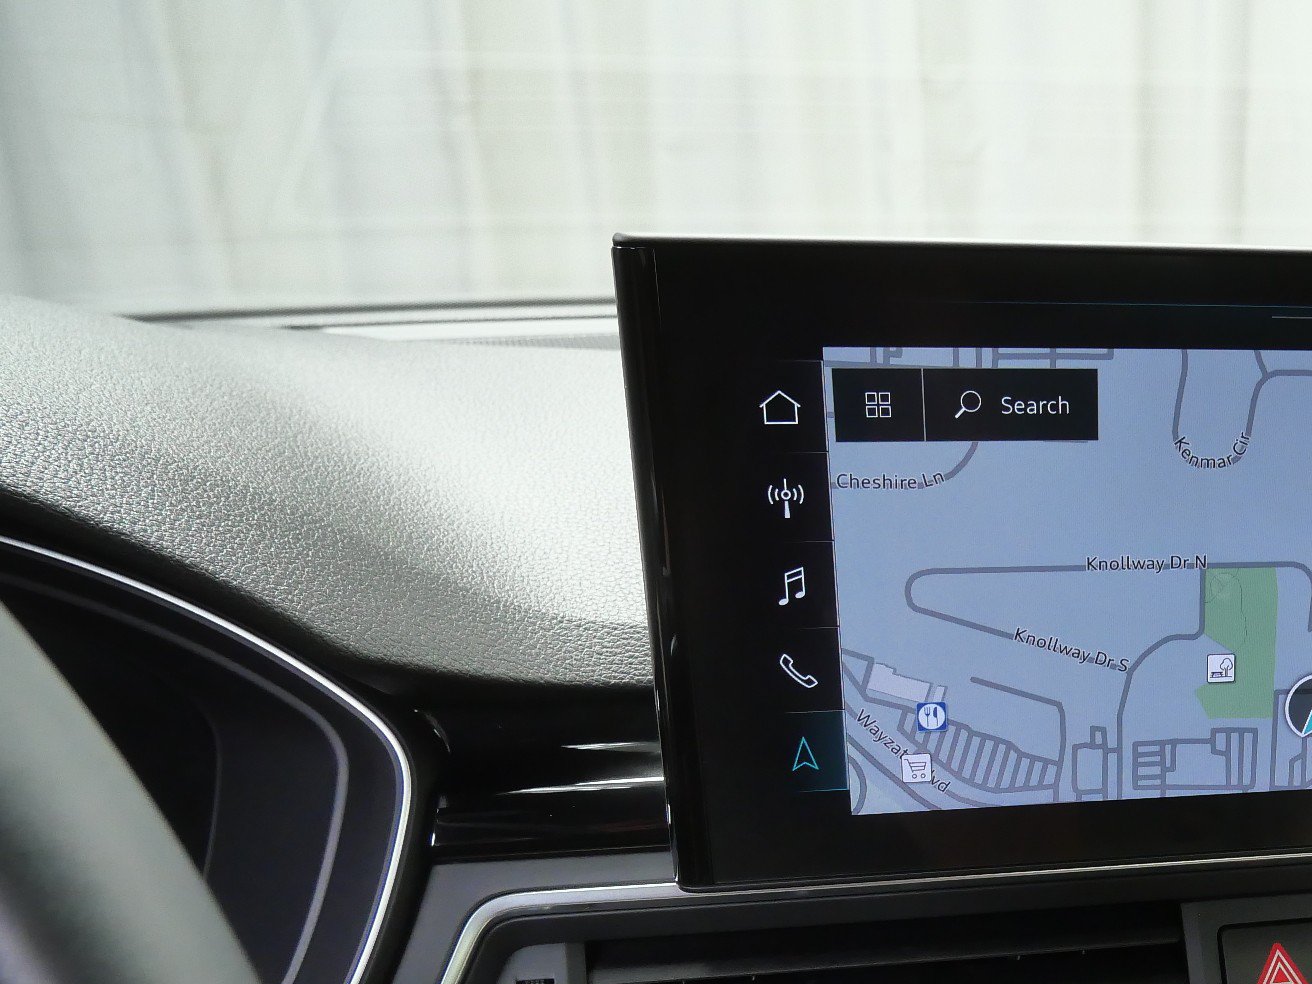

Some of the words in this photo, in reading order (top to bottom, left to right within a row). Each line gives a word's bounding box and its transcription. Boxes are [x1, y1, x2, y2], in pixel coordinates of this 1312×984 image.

[1001, 395, 1070, 415] Search
[1174, 436, 1233, 469] Kenmar
[1232, 431, 1250, 456] Cir
[836, 473, 918, 490] Cheshire
[921, 471, 945, 488] Ln
[1086, 555, 1165, 574] Knollway
[1169, 555, 1190, 569] Dr
[1194, 555, 1208, 569] N
[1013, 627, 1091, 664] Knollway
[1094, 651, 1115, 668] Dr
[1117, 658, 1130, 672] S
[856, 708, 909, 759] Wayzat
